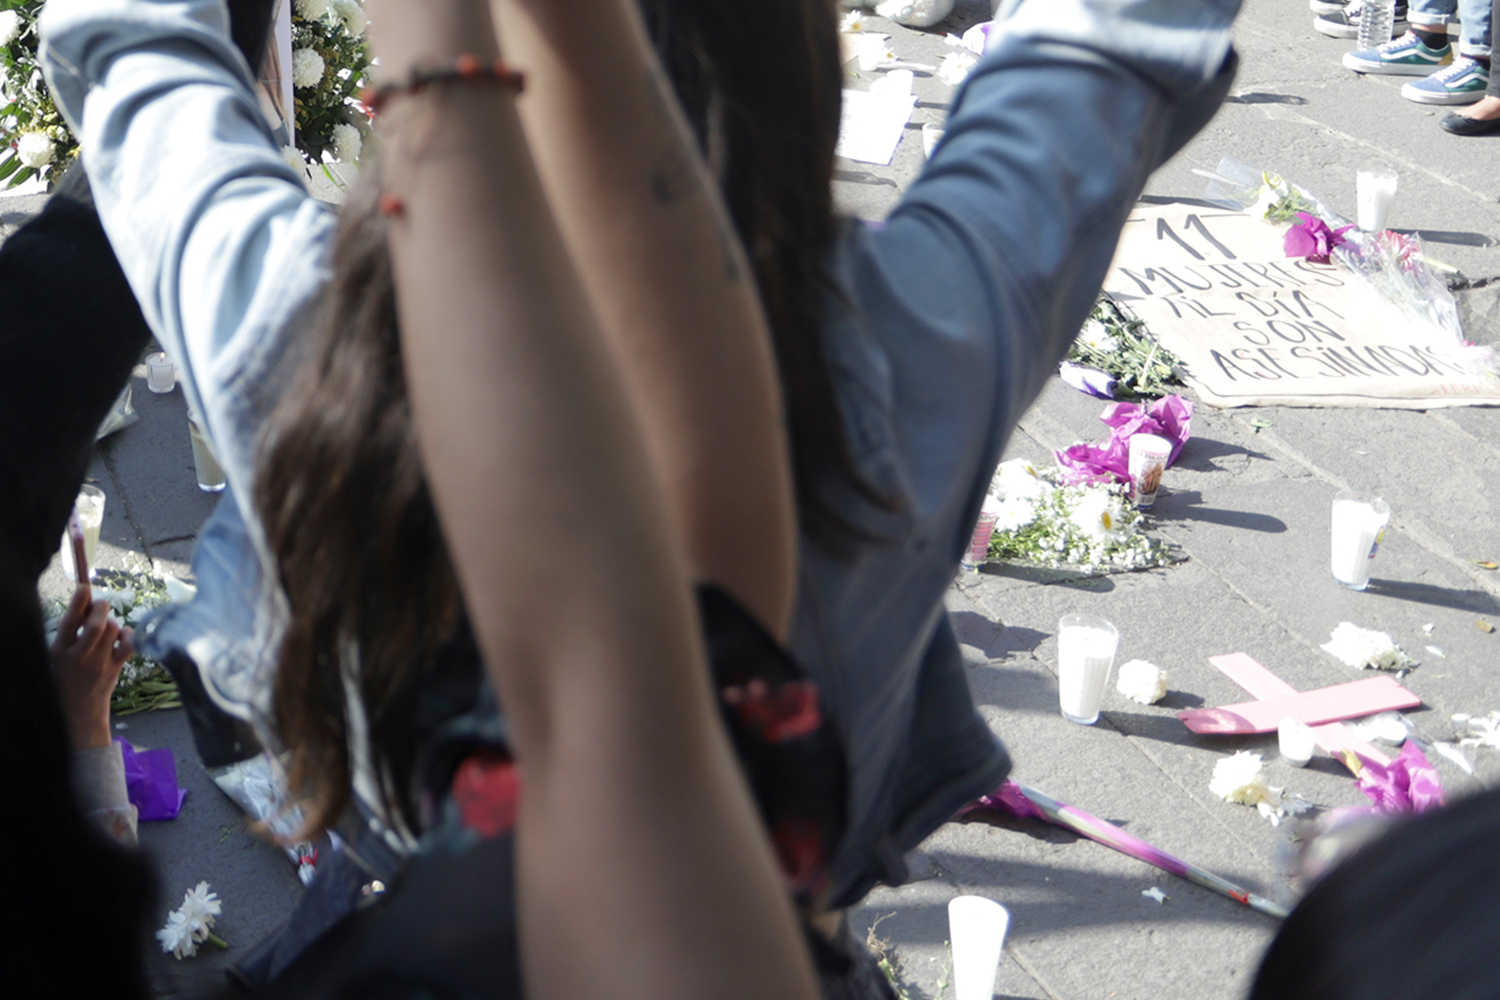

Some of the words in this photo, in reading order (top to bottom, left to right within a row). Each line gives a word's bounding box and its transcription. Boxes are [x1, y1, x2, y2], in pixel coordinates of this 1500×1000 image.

[1156, 213, 1237, 261] 11
[1118, 260, 1345, 296] MUJERES
[1233, 320, 1346, 346] SON
